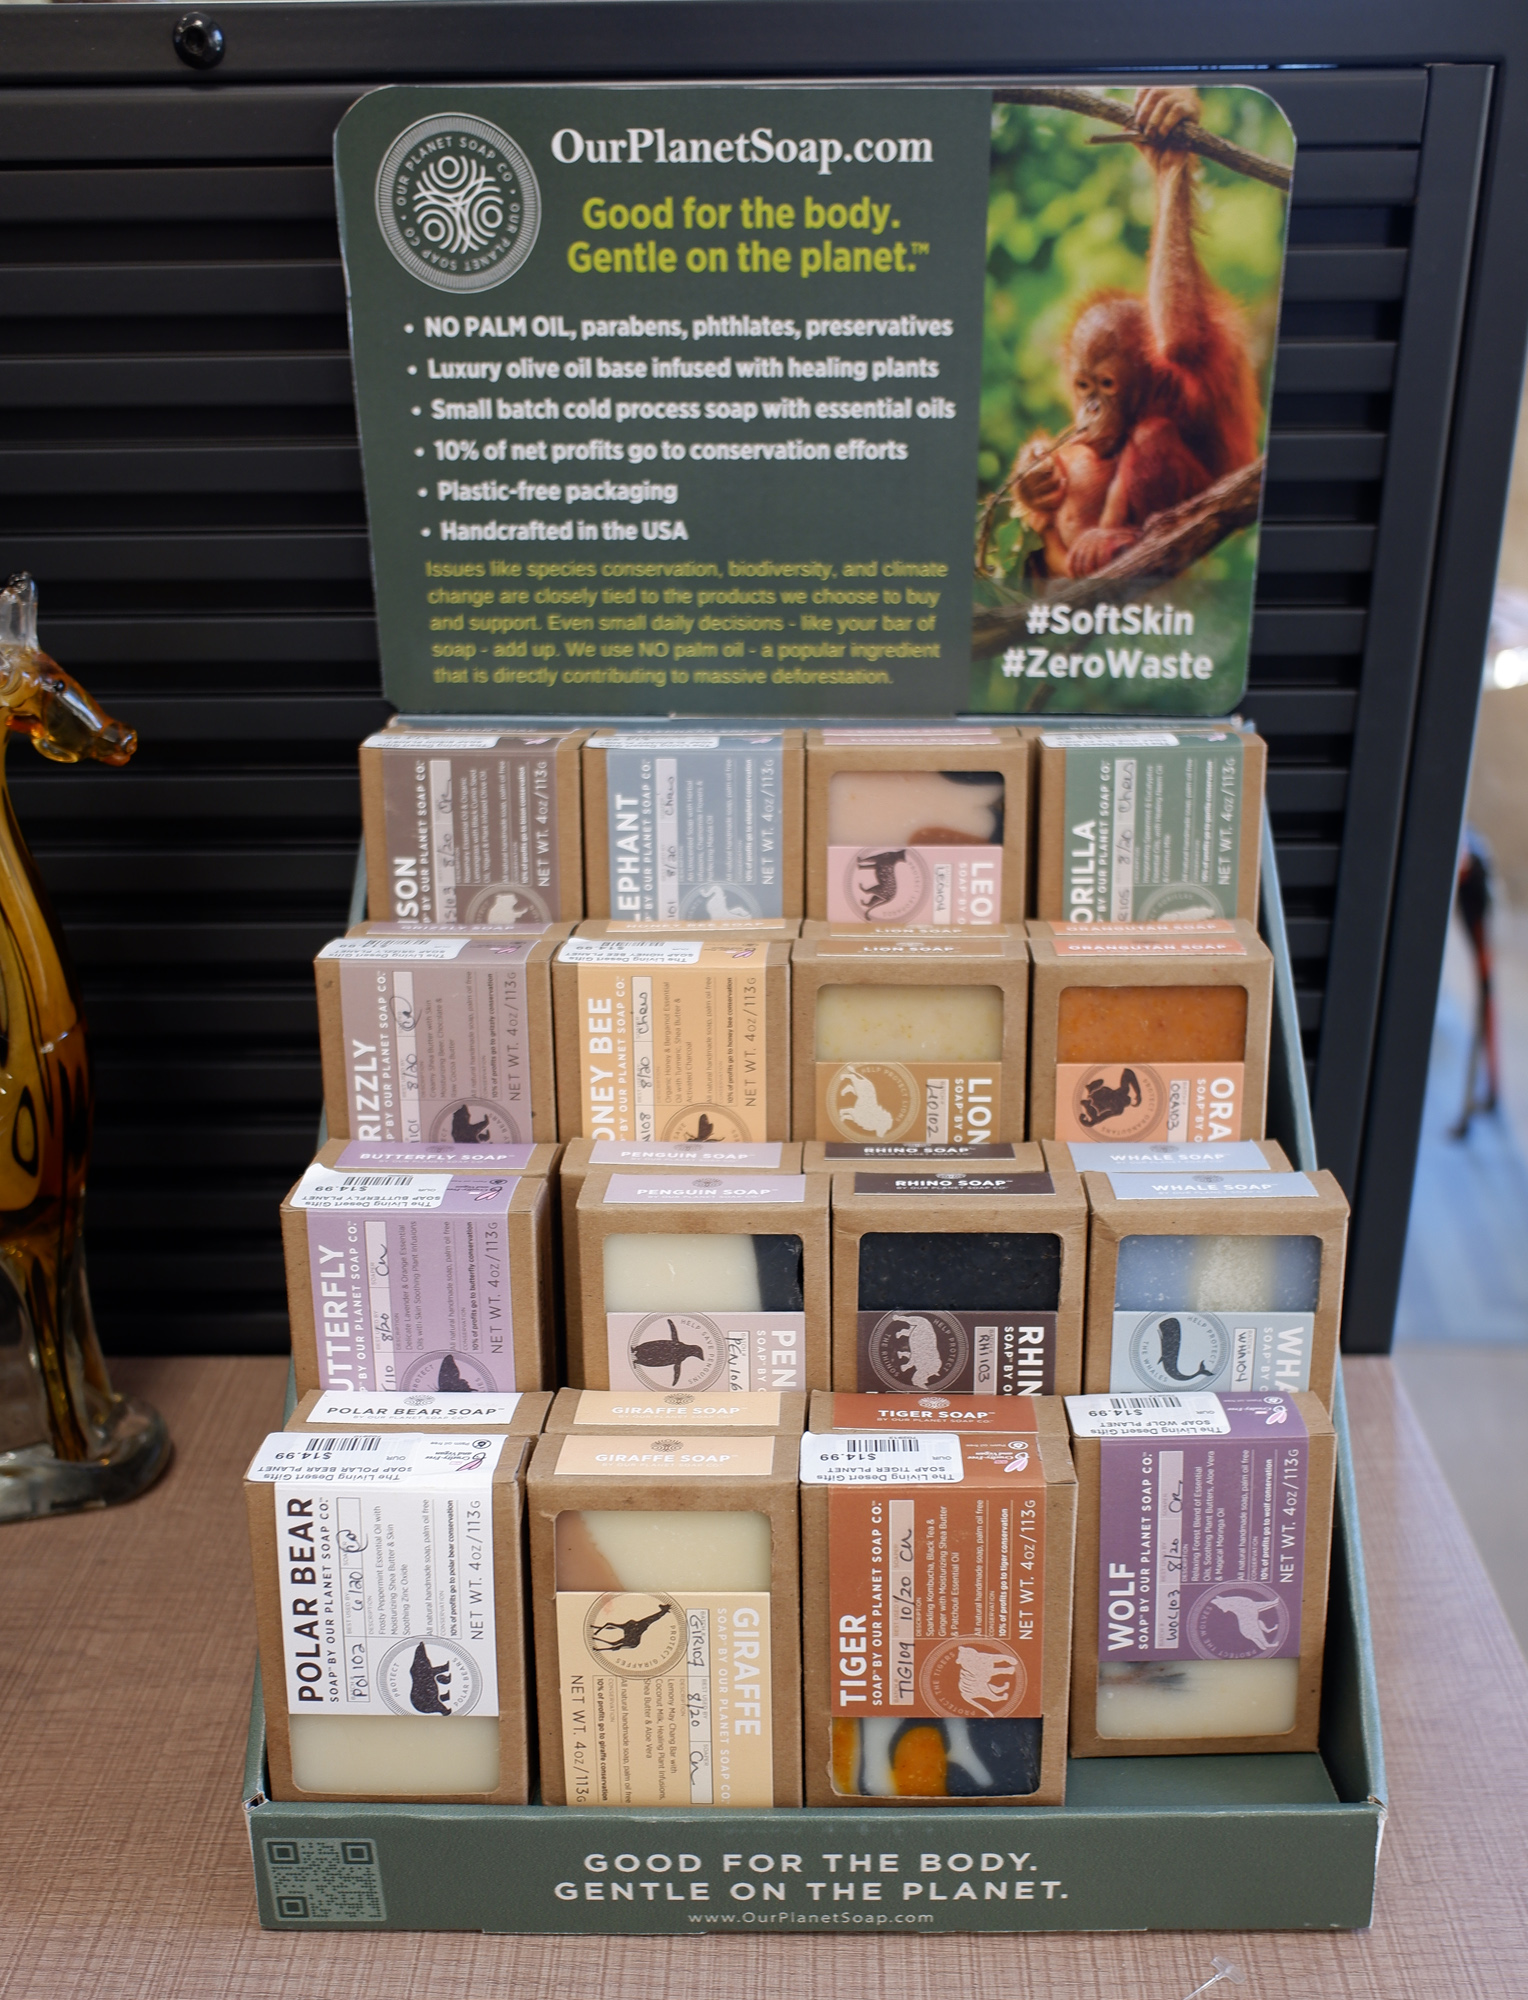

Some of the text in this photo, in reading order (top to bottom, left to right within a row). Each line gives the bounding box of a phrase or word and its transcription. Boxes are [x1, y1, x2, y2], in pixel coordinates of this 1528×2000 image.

[551, 127, 934, 176] OurPlanetSoap.com
[395, 136, 514, 207] OUR PLANET SOAP CO
[582, 195, 901, 235] Good for the body.
[567, 240, 678, 273] Gentle
[685, 247, 729, 273] on
[736, 240, 792, 273] the
[424, 314, 954, 341] NO PALM OIL, parabens, phthlates, preservatives
[427, 356, 940, 383] Luxury olive oil base infused with healing plants
[431, 397, 956, 423] Small batch cold process soap with essential oils
[433, 438, 909, 464] 10% of net profits go to conservation efforts
[437, 480, 678, 505] Plastic-free packaging
[440, 520, 688, 541] Handcrafted in the USA
[425, 560, 949, 581] Issues like species conservation, biodiversity, and climate
[1025, 603, 1196, 637] #SoftSkin
[433, 667, 893, 688] that is directly contributing to massive deforestation.
[1001, 648, 1214, 681] #ZeroWaste
[587, 998, 613, 1054] BEE
[744, 1048, 757, 1075] WT.
[744, 1079, 757, 1107] NET
[488, 1294, 502, 1320] WT.
[490, 1326, 504, 1354] NET
[326, 1407, 388, 1415] POLAR
[611, 1406, 688, 1415] GIRAFFE
[877, 1409, 933, 1420] TIGER
[594, 1454, 675, 1465] GIRAFFE
[820, 1453, 876, 1461] $14.99
[891, 1473, 928, 1482] Living
[1279, 1448, 1300, 1583] NET WT. 4oz/113G
[871, 1528, 883, 1563] SOAP
[1018, 1499, 1037, 1640] NET WT. 4oz/113G
[286, 1498, 324, 1702] POLAR BEAR
[468, 1577, 483, 1605] WT.
[871, 1568, 883, 1617] PLANET
[1107, 1562, 1136, 1651] WOLF
[469, 1610, 484, 1640] NET
[871, 1621, 883, 1647] OUR
[732, 1607, 761, 1736] GIRAFFE
[839, 1614, 868, 1707] TIGER
[871, 1652, 883, 1668] BY
[570, 1675, 585, 1702] NET
[572, 1709, 587, 1736] WT.
[583, 1852, 1037, 1873] GOOD FOR THE BODY.
[554, 1880, 1068, 1901] GENTLE ON THE PLANET.
[687, 1911, 934, 1926] www.OurPlanetSoap.com
